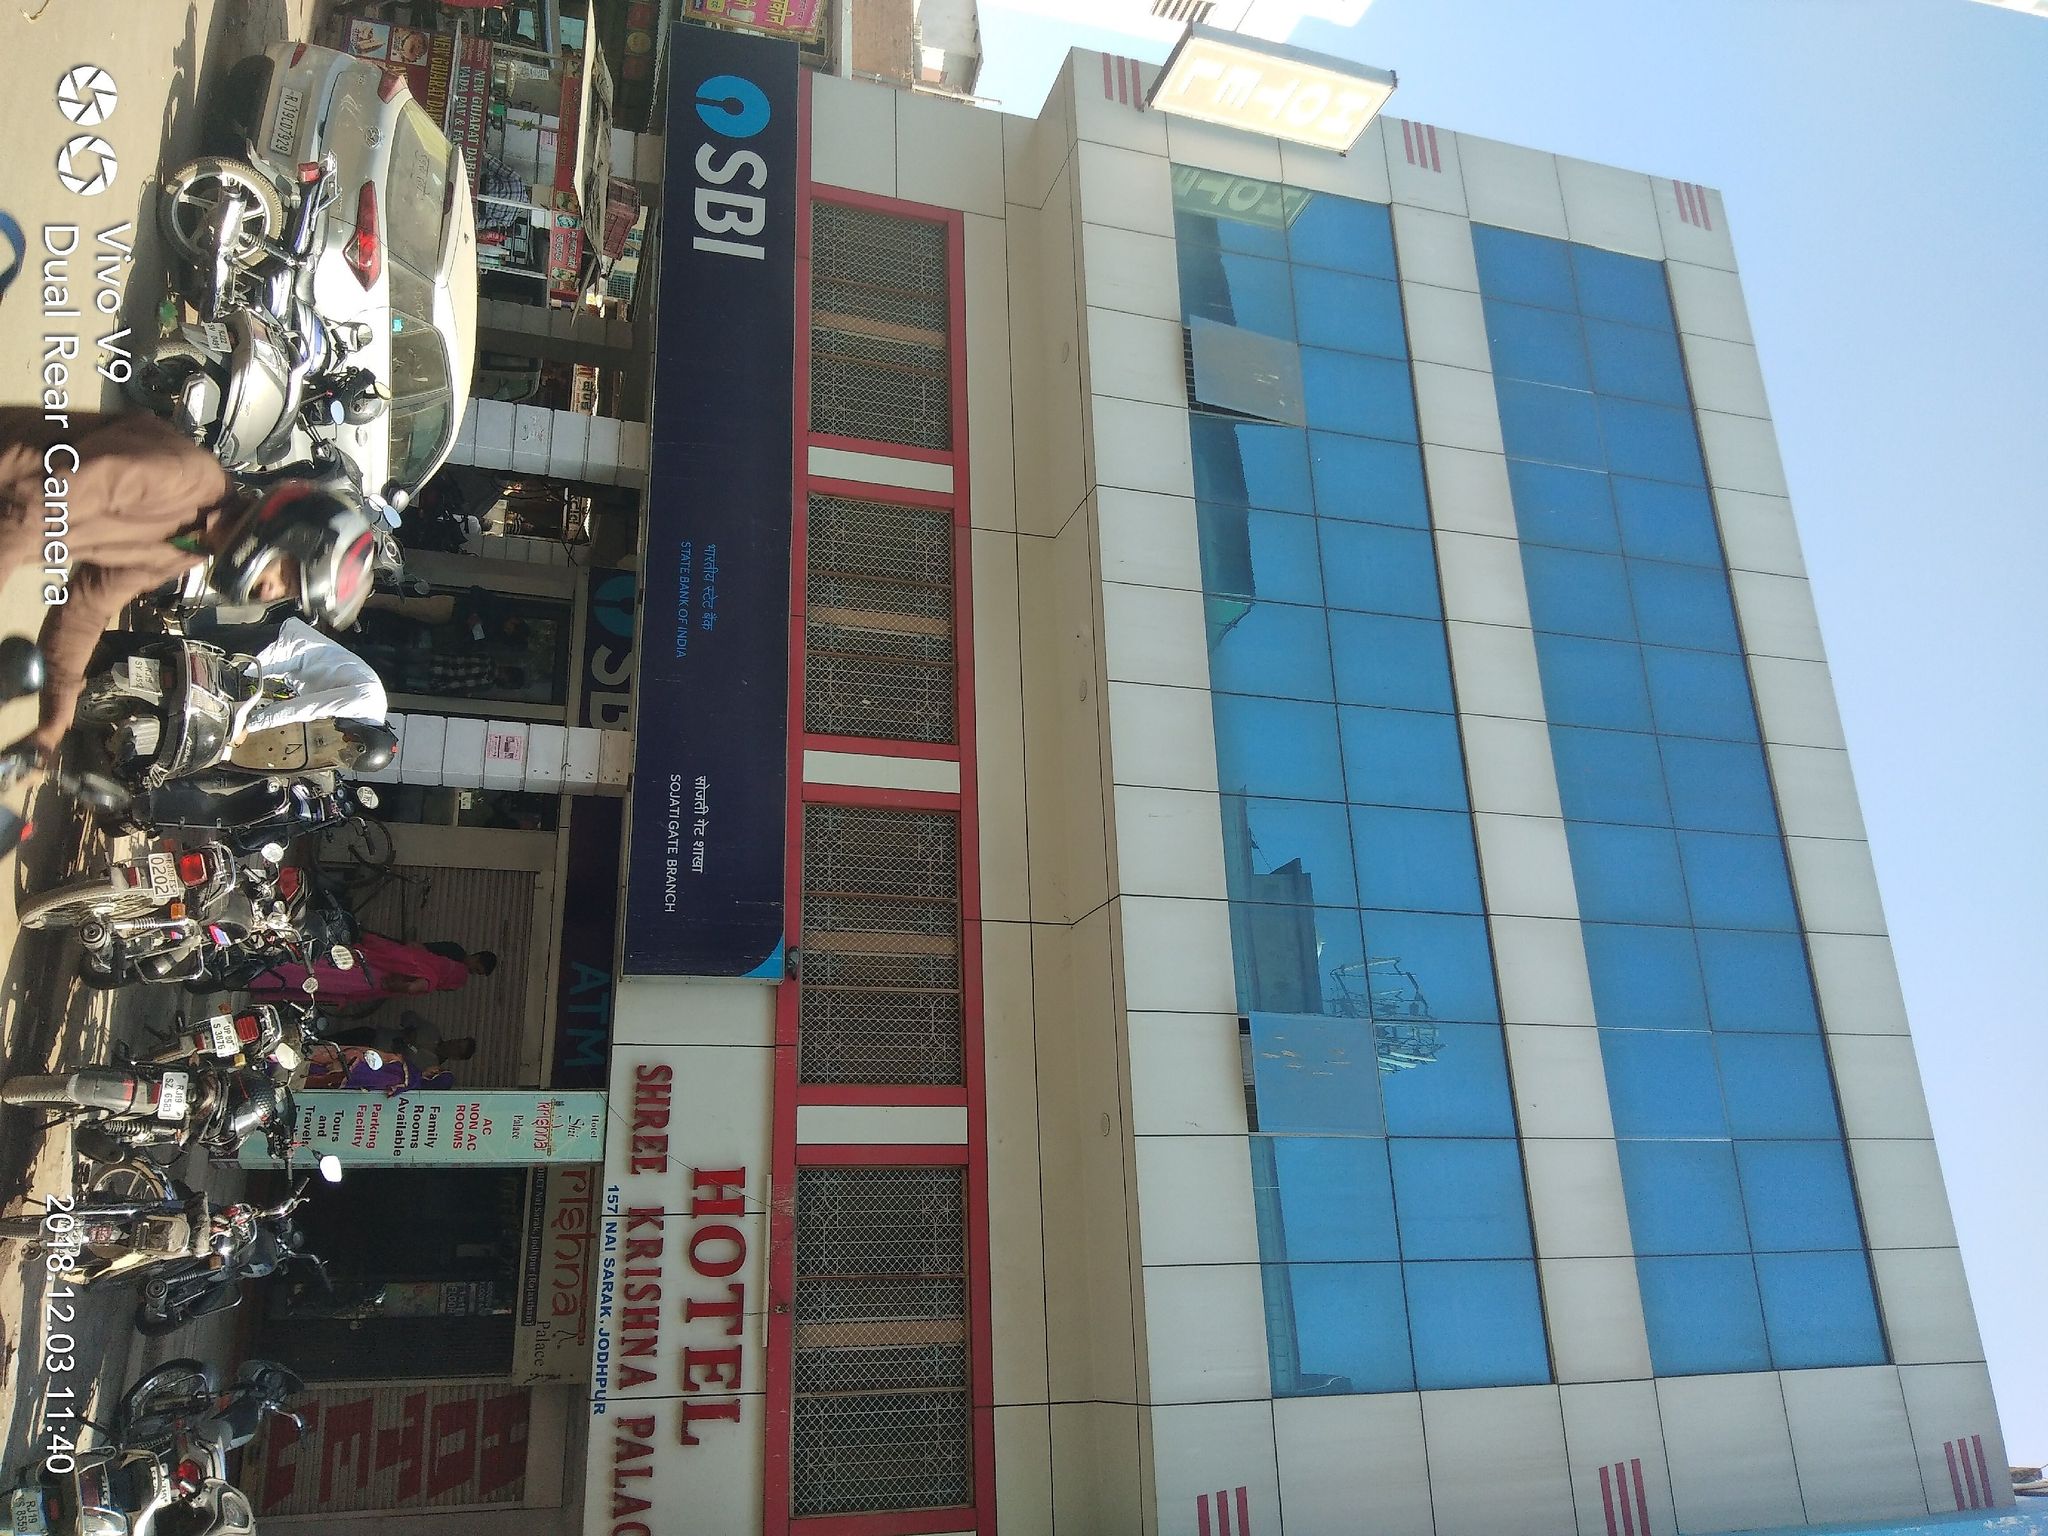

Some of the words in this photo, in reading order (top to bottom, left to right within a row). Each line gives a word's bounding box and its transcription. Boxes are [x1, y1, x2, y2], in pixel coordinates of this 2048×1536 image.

[433, 34, 452, 56] NEW
[428, 57, 448, 99] GUJARAT
[458, 66, 470, 92] VADA
[472, 70, 486, 95] NEW
[456, 96, 468, 116] PAV
[1175, 57, 1372, 136] HOTEL
[454, 118, 466, 126] &
[467, 96, 483, 145] GUJARAT
[693, 142, 768, 260] SBI
[680, 541, 692, 574] STATE
[703, 544, 719, 582] भारतीय
[678, 576, 690, 606] BANK
[702, 586, 718, 610] स्टेट
[678, 608, 688, 624] OF
[701, 612, 718, 631] बैंक
[676, 626, 688, 659] INDIA
[669, 774, 682, 818] SOJATI
[694, 775, 710, 815] सोजती
[667, 820, 680, 854] GATE
[693, 818, 709, 836] गेट
[691, 840, 705, 874] शाखा
[150, 857, 169, 894] 0202
[664, 859, 678, 912] BRANCH
[222, 1025, 231, 1034] UP
[563, 961, 612, 1067] ATM
[164, 1078, 174, 1088] SZ
[174, 1085, 184, 1103] RJ19
[301, 1105, 316, 1147] Travels
[317, 1115, 327, 1137] and
[332, 1110, 344, 1142] Tours
[352, 1104, 367, 1148] Facility
[366, 1103, 382, 1150] Parking
[393, 1097, 410, 1157] Available
[410, 1105, 424, 1149] Rooms
[424, 1106, 440, 1148] Family
[452, 1104, 466, 1150] ROOMS
[468, 1103, 480, 1130] NON
[482, 1118, 492, 1136] AC
[511, 1115, 524, 1140] Palace
[590, 1115, 600, 1138] Hotel
[630, 1064, 673, 1175] SHREE
[466, 1134, 477, 1151] AC
[606, 1184, 620, 1214] 157
[604, 1222, 618, 1252] NAI
[528, 1236, 540, 1272] Jodhpur
[617, 1206, 665, 1391] KRISHNA
[680, 1166, 748, 1446] HOTEL
[534, 1320, 552, 1368] Palace
[592, 1327, 610, 1416] JODHPUR
[26, 1501, 38, 1524] RJ19
